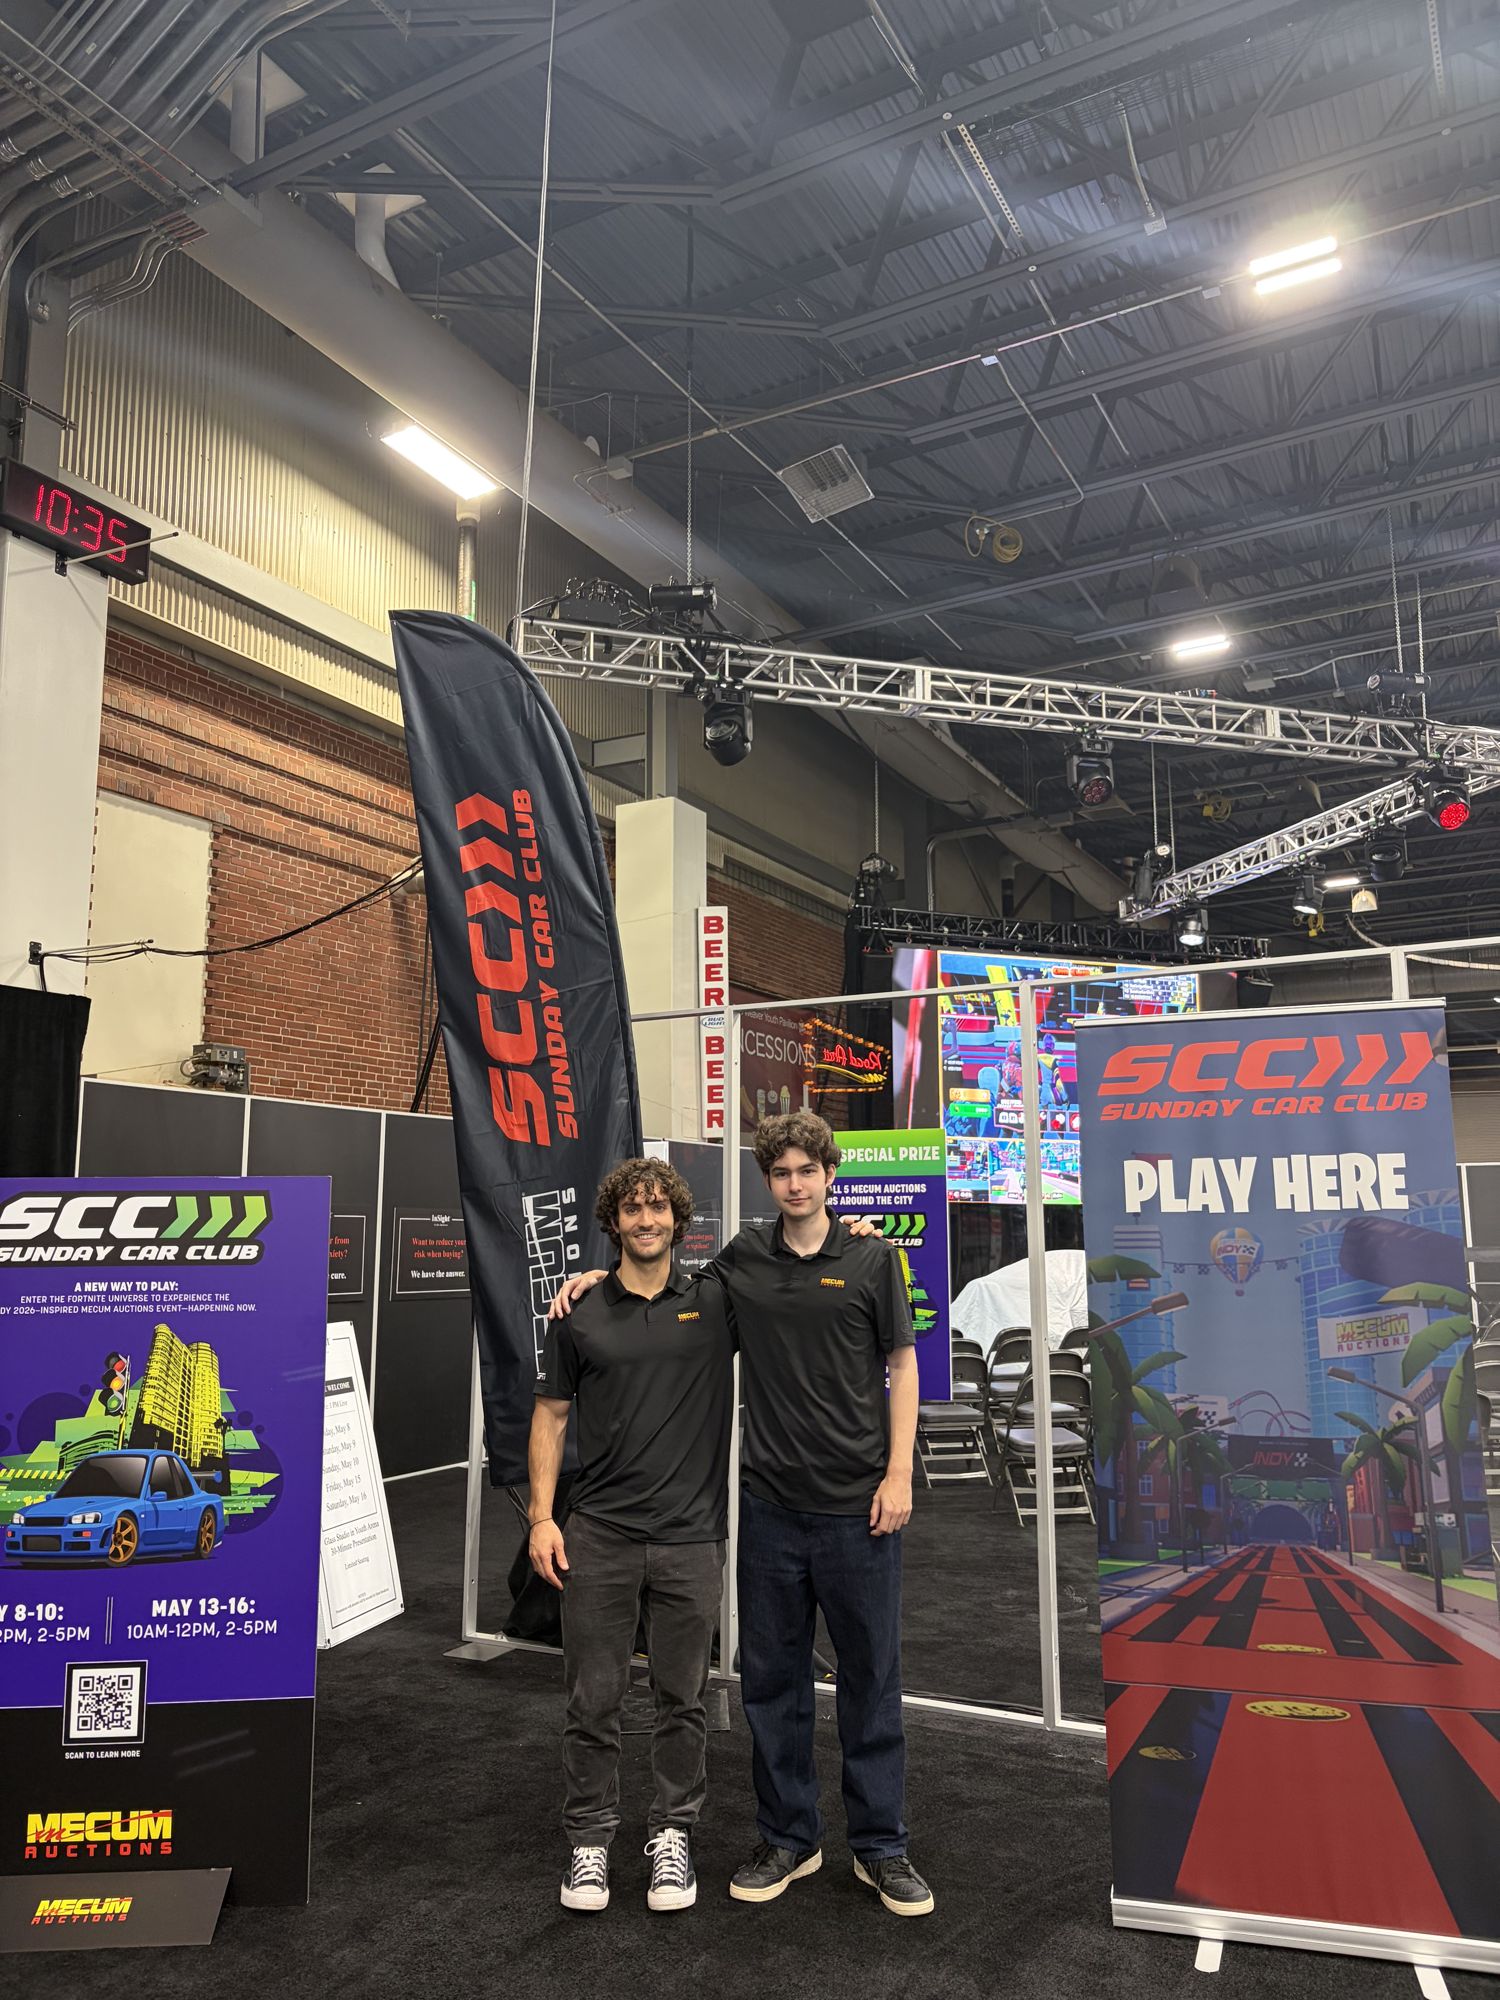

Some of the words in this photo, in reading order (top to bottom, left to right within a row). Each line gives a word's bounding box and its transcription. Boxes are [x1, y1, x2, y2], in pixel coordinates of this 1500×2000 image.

[33, 484, 128, 563] 10:35
[511, 788, 542, 882] CLUB
[528, 893, 555, 969] CAR
[703, 916, 724, 1006] BEER
[467, 922, 552, 1147] SCC
[539, 979, 579, 1140] SUNDAY
[1097, 1038, 1307, 1096] SCC
[705, 1036, 725, 1128] BEER
[1101, 1099, 1243, 1121] SUNDAY
[1252, 1096, 1321, 1116] CAR
[1333, 1092, 1428, 1113] CLUB
[841, 1147, 896, 1162] SPECIAL
[899, 1146, 940, 1161] PRIZE
[830, 1186, 842, 1194] LL
[844, 1185, 850, 1194] 5
[851, 1185, 881, 1194] MECUM
[884, 1184, 927, 1193] AUCTIONS
[1124, 1157, 1257, 1213] PLAY
[1272, 1152, 1409, 1212] HERE
[825, 1197, 838, 1205] RS
[840, 1196, 874, 1205] AROUND
[876, 1196, 892, 1205] THE
[894, 1196, 914, 1205] CITY
[0, 1197, 172, 1240] SCC
[334, 1236, 350, 1245] from
[412, 1237, 427, 1246] Want
[428, 1238, 435, 1246] to
[436, 1238, 454, 1246] reduce
[892, 1238, 923, 1246] CLUB
[0, 1246, 115, 1262] SUNDAY
[120, 1246, 179, 1260] CAR
[185, 1245, 259, 1260] CLUB
[329, 1249, 348, 1260] xiety?
[414, 1250, 426, 1258] risk
[426, 1250, 442, 1258] when
[330, 1272, 347, 1280] cure.
[411, 1270, 420, 1278] We
[421, 1270, 435, 1278] have
[435, 1269, 444, 1278] the
[74, 1282, 82, 1292] A
[84, 1282, 108, 1292] NEW
[110, 1282, 133, 1292] WAY
[135, 1282, 148, 1292] TO
[150, 1281, 179, 1292] PLAY:
[20, 1296, 47, 1304] ENTER
[50, 1295, 65, 1303] THE
[67, 1295, 106, 1303] FORTNITE
[108, 1294, 149, 1302] UNIVERSE
[151, 1294, 161, 1302] TO
[163, 1294, 212, 1302] EXPERIENCE
[215, 1293, 230, 1301] THE
[81, 1305, 111, 1314] MECUM
[113, 1305, 154, 1313] AUCTIONS
[236, 1304, 257, 1312] NOW.
[1336, 1313, 1409, 1343] MECUM
[1337, 1335, 1410, 1352] AUCTIONS
[341, 1441, 352, 1451] May
[341, 1460, 352, 1470] May
[1254, 1451, 1294, 1465] INDY
[343, 1477, 354, 1488] May
[348, 1494, 360, 1504] May
[323, 1537, 336, 1546] Glass
[336, 1531, 350, 1542] Studio
[354, 1525, 367, 1535] Youth
[352, 1534, 377, 1548] Presentation
[14, 1603, 64, 1622] 8-10:
[152, 1599, 193, 1617] MAY
[199, 1597, 256, 1615] 13-16:
[37, 1626, 90, 1642] 2-5PM
[127, 1622, 220, 1639] 10AM-12PM,
[225, 1620, 278, 1636] 2-5PM
[65, 1752, 84, 1760] SCAN
[96, 1751, 119, 1759] LEARN
[121, 1750, 141, 1758] MORE
[26, 1810, 173, 1843] MECUM
[24, 1841, 173, 1859] AUCTIONS
[35, 1897, 133, 1917] MECUM
[31, 1914, 128, 1925] AUCTIONS
